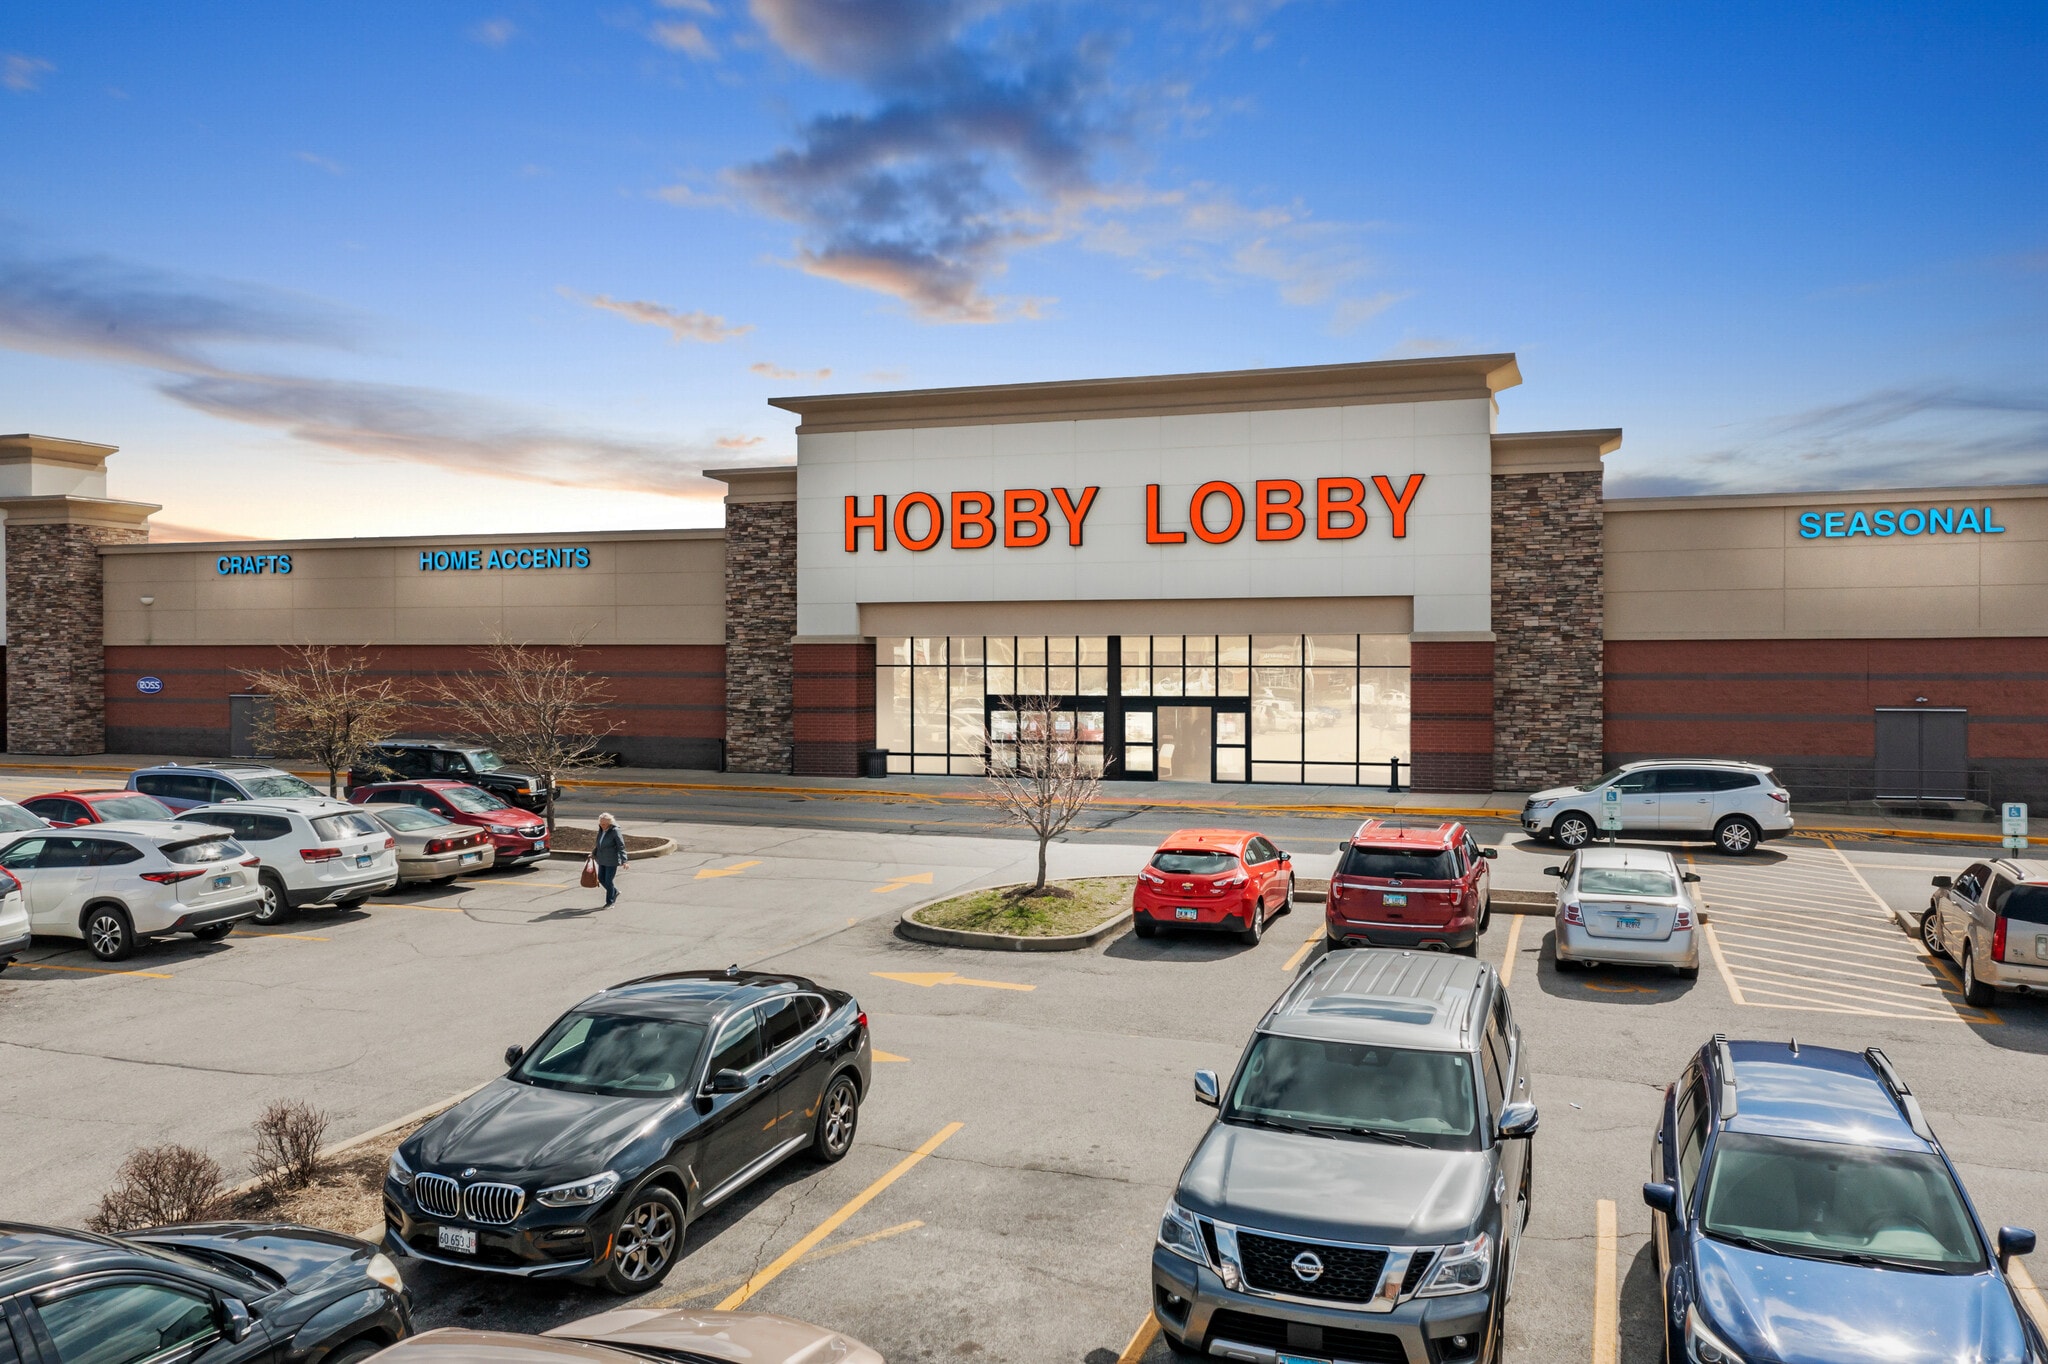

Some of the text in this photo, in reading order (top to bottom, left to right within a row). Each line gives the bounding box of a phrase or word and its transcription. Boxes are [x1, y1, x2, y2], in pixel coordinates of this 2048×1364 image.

[843, 473, 1426, 553] HOBBY LOBBY
[1799, 506, 2006, 538] SEASONAL
[216, 554, 293, 575] CRAFTS
[419, 547, 591, 571] HOME ACCENTS
[139, 681, 160, 689] ROSS
